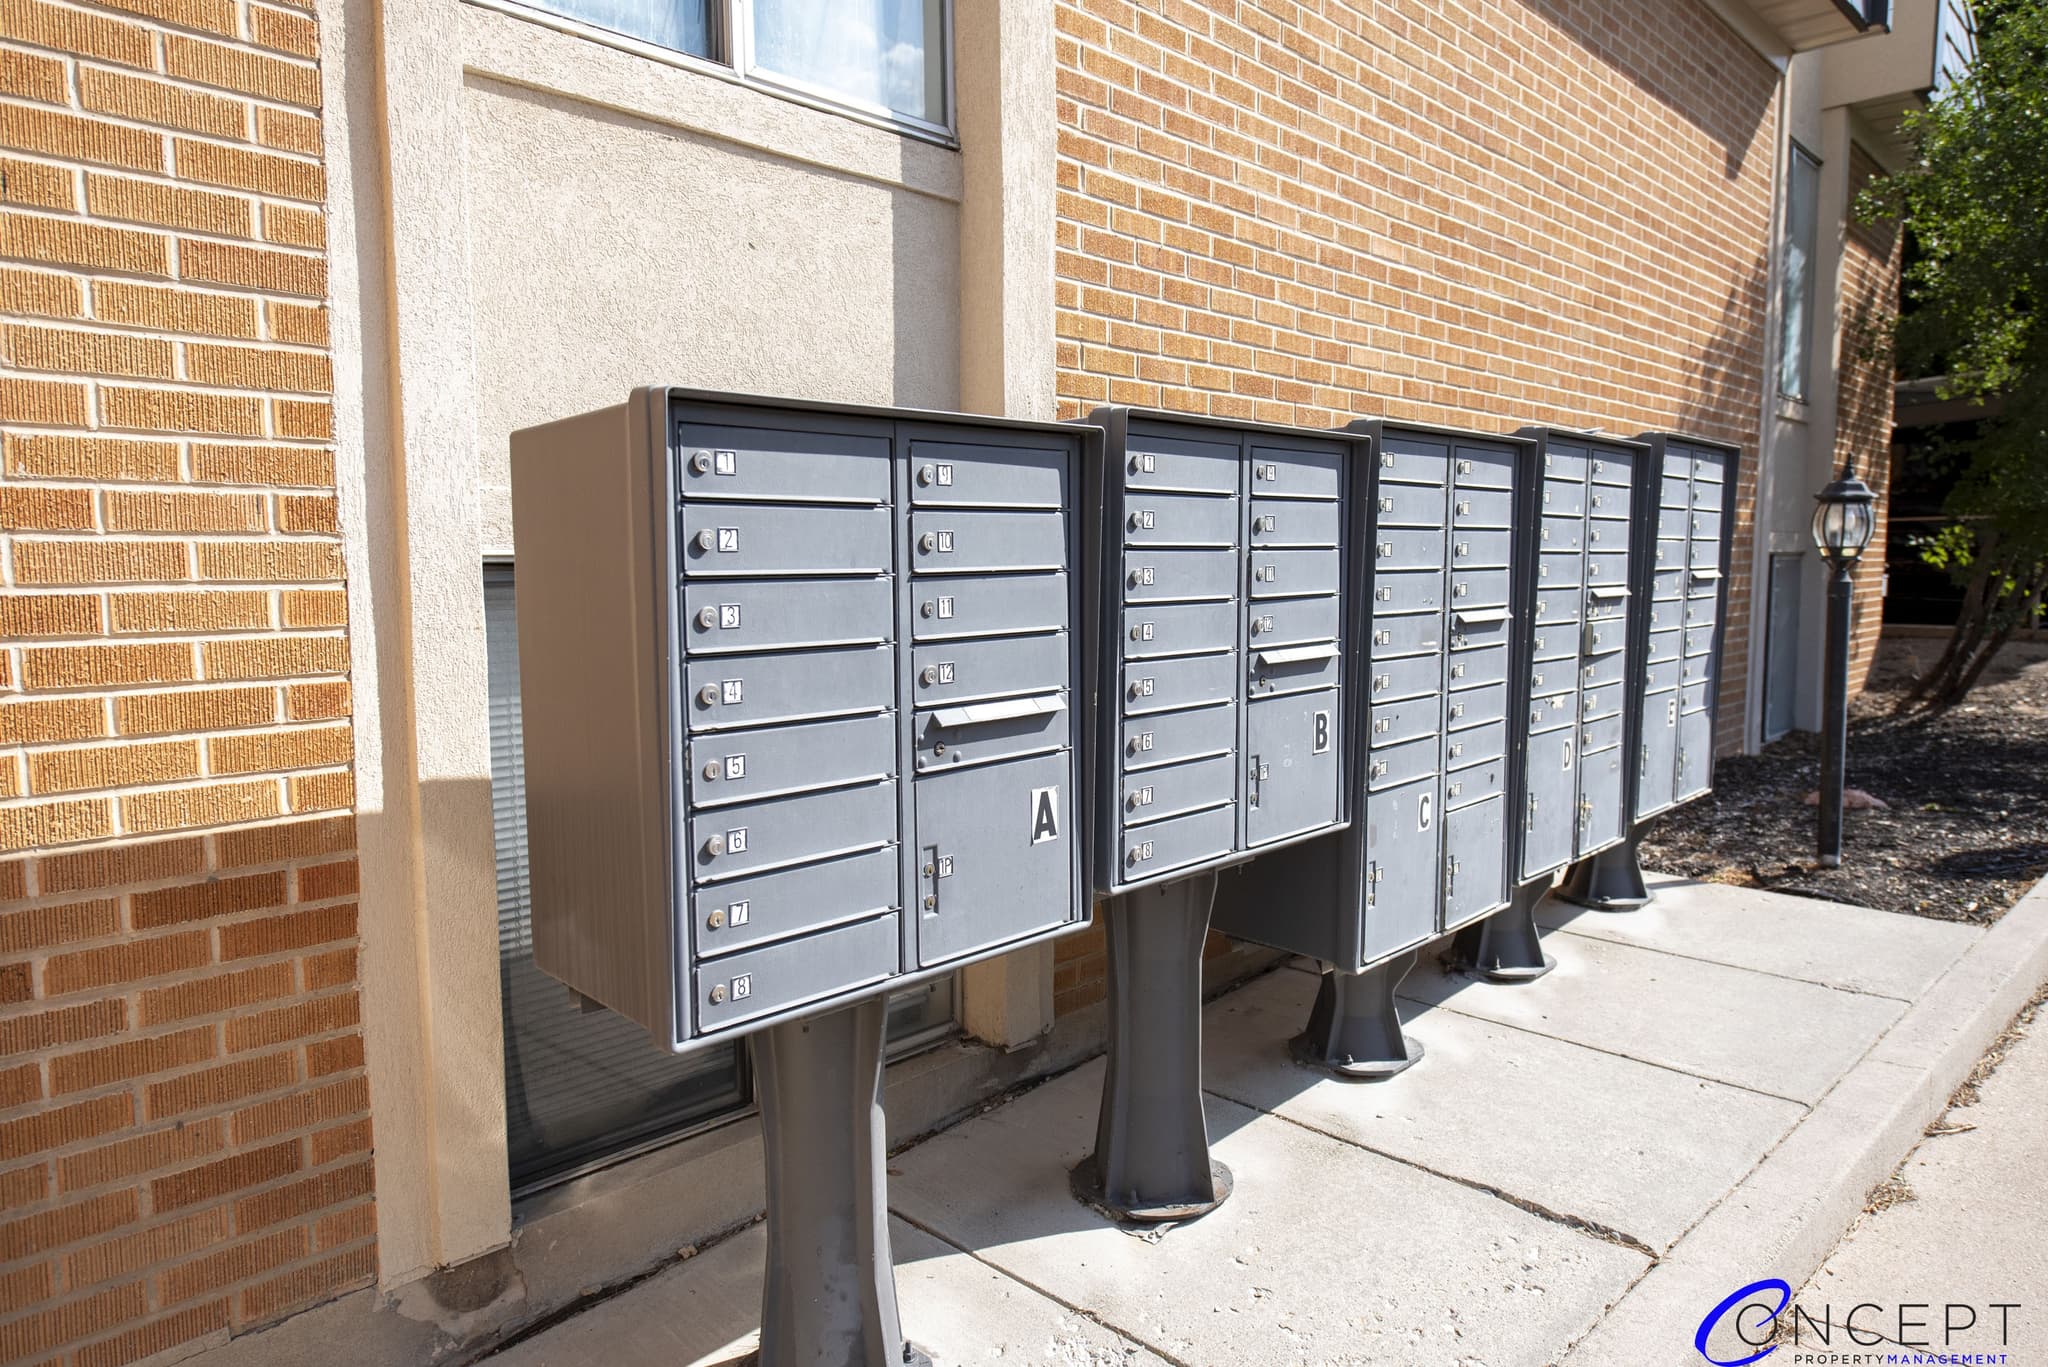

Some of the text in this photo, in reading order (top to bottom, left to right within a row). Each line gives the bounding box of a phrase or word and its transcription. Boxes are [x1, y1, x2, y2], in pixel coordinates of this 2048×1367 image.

[942, 466, 949, 481] 9
[725, 529, 733, 548] 2
[940, 533, 952, 549] 10
[1145, 569, 1151, 583] 3
[727, 606, 735, 625] 3
[941, 599, 951, 615] 11
[1145, 625, 1151, 638] 4
[941, 664, 952, 680] 12
[729, 682, 737, 700] 4
[1145, 680, 1151, 693] 5
[1315, 713, 1328, 750] B
[1145, 735, 1151, 748] 6
[1564, 741, 1571, 768] D
[733, 756, 740, 775] 5
[1034, 791, 1057, 840] A
[1420, 795, 1429, 828] C
[734, 831, 742, 849] 6
[1145, 843, 1151, 857] 8
[940, 857, 952, 876] 1P
[736, 904, 744, 921] 7
[738, 977, 746, 995] 8
